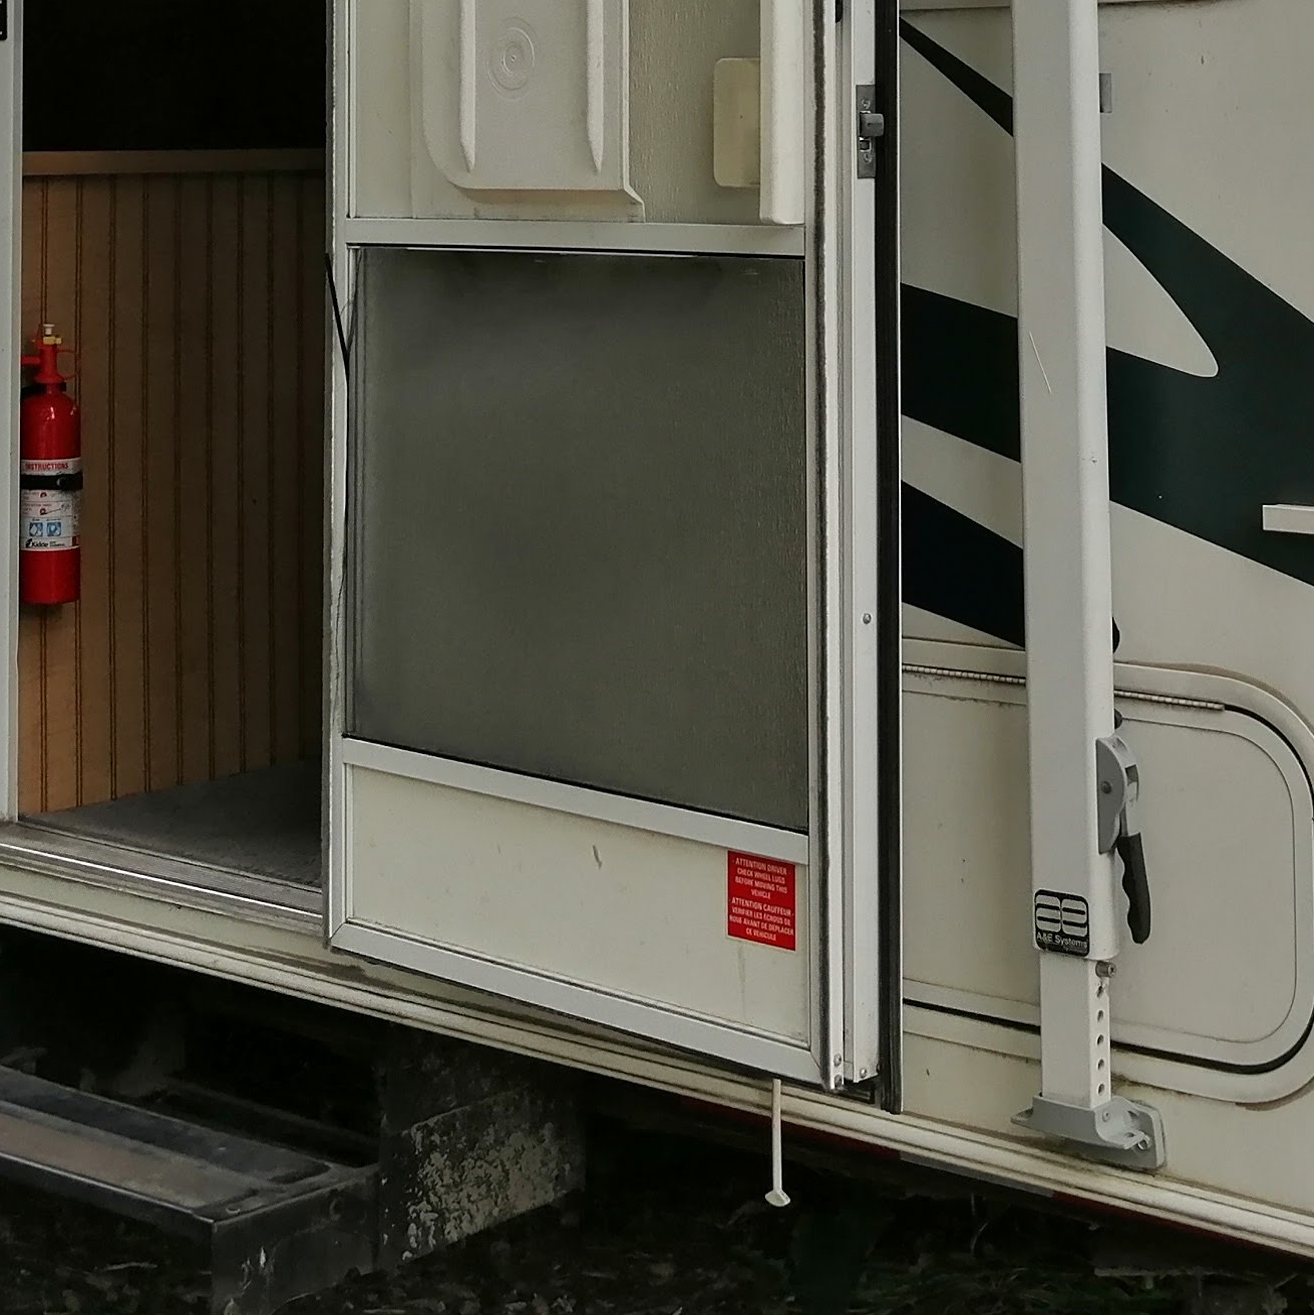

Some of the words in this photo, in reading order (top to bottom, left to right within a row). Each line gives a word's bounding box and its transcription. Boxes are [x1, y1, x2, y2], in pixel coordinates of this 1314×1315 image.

[25, 462, 69, 471] INSTRUCTIONS
[735, 858, 766, 871] ATTENTION
[767, 864, 787, 875] DRIVER
[737, 867, 754, 877] CHECK
[754, 871, 771, 881] WHEEL
[771, 875, 785, 884] LUGS
[735, 876, 754, 886] BEFORE
[754, 880, 775, 891] MOVING
[775, 884, 787, 894] THIS
[750, 888, 771, 899] VEHICLE
[731, 896, 762, 910] ATTENTION
[729, 915, 742, 924] ROUE
[743, 918, 760, 928] AVANT
[760, 922, 768, 930] DE
[753, 911, 763, 919] LES
[783, 918, 791, 926] DE
[745, 927, 753, 935] CE
[1036, 931, 1053, 943] A&E
[1054, 934, 1088, 948] Systems
